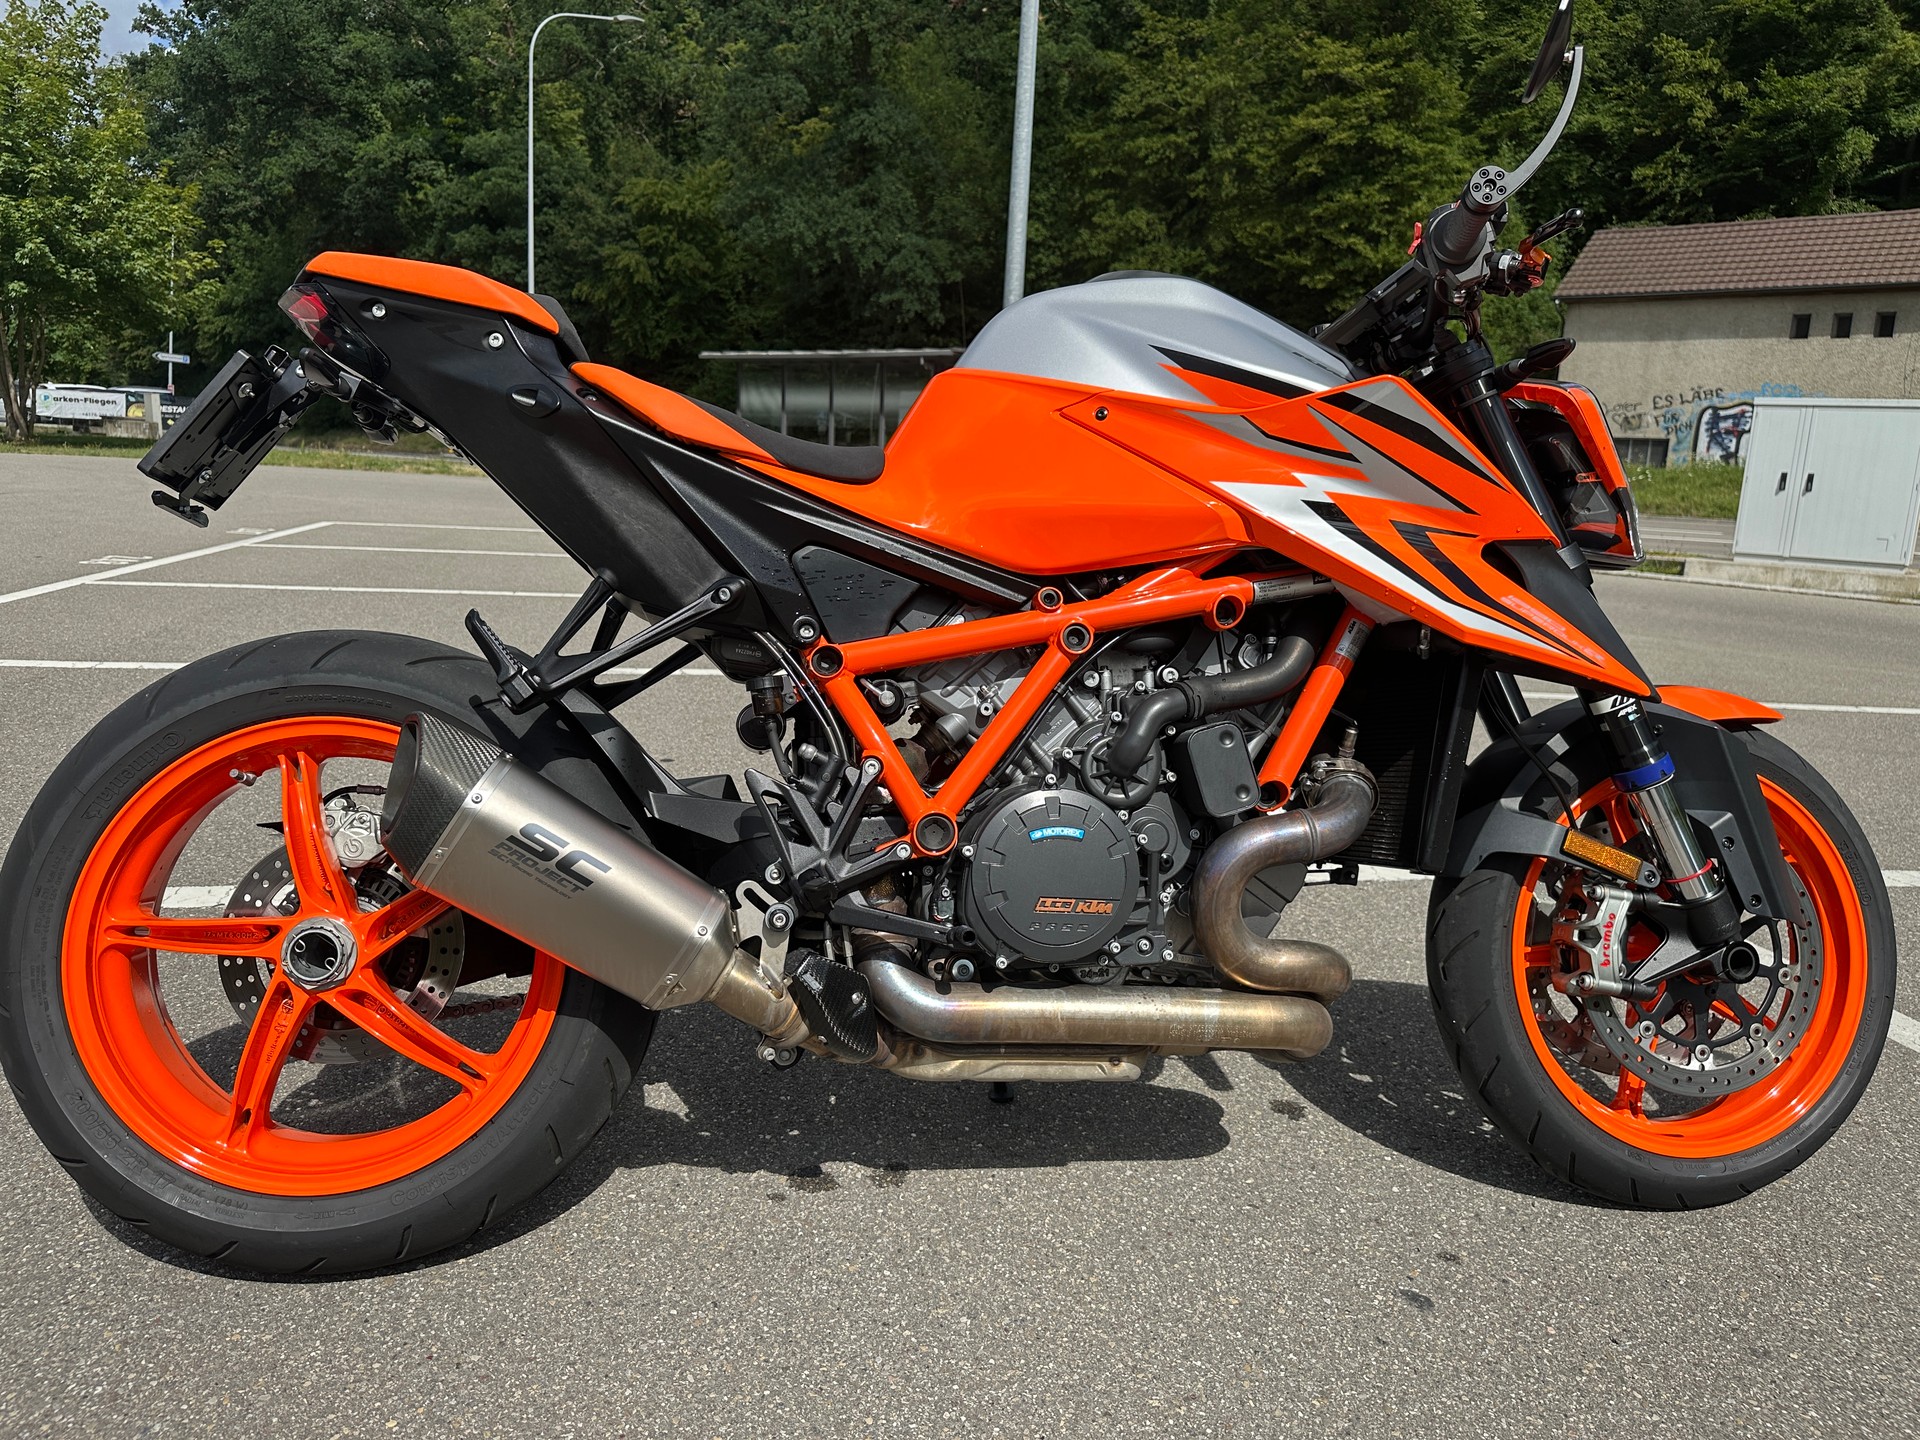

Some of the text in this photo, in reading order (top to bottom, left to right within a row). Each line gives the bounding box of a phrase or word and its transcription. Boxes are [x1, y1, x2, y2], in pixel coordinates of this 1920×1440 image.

[1652, 394, 1673, 410] ES
[92, 731, 185, 810] Continental
[505, 823, 613, 887] SC
[1043, 827, 1080, 837] MOTOREX
[495, 842, 585, 893] PROJECT
[1075, 900, 1113, 914] KTM
[1600, 913, 1616, 967] brembo
[64, 1087, 121, 1150] 200/55
